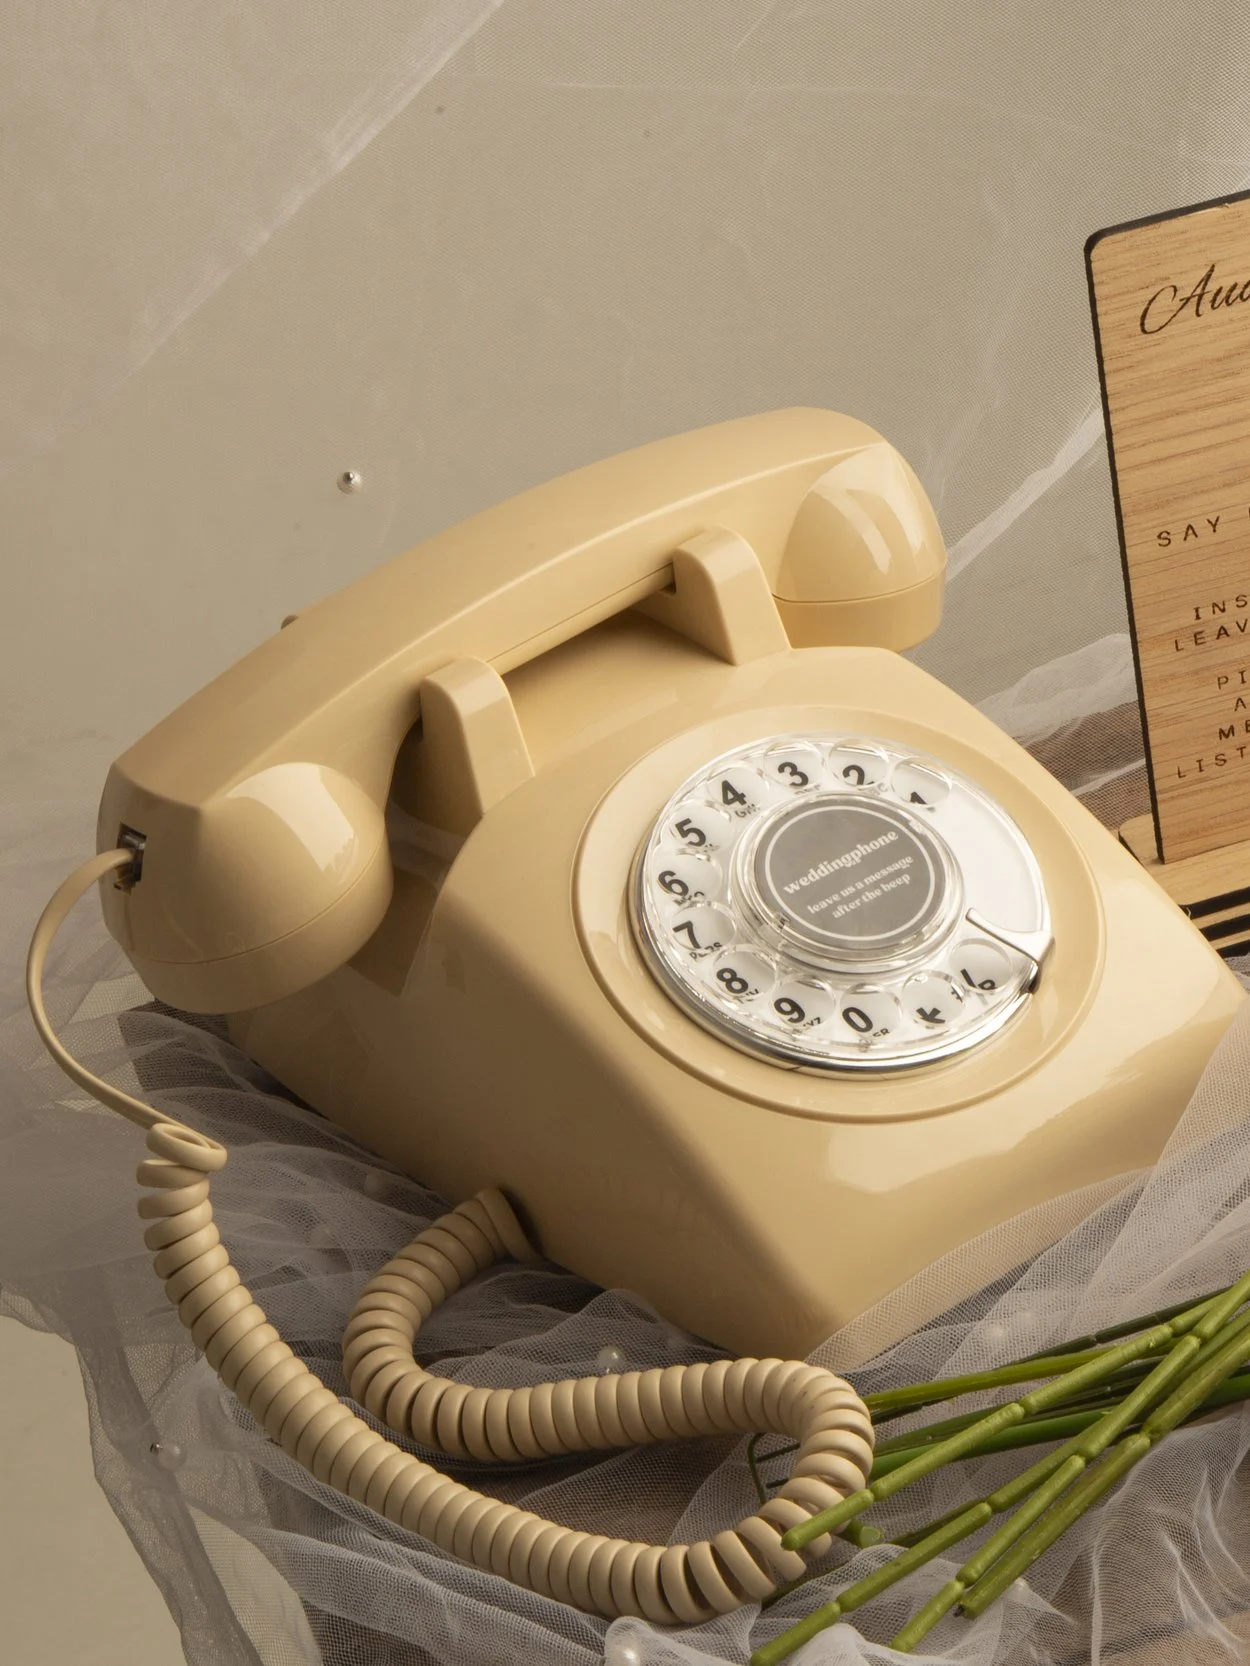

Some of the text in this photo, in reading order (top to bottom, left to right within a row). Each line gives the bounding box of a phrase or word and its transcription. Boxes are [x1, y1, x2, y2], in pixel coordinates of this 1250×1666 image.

[1156, 516, 1222, 548] SAY
[778, 762, 808, 787] 3
[721, 780, 746, 806] 4
[675, 818, 706, 847] 5
[783, 830, 898, 895] weddingphone
[658, 870, 689, 896] 6
[807, 855, 914, 914] leave us a message
[832, 873, 911, 919] after the beep
[673, 921, 701, 949] 7
[716, 968, 749, 994] 8
[774, 998, 805, 1024] 9
[842, 1007, 873, 1033] 0
